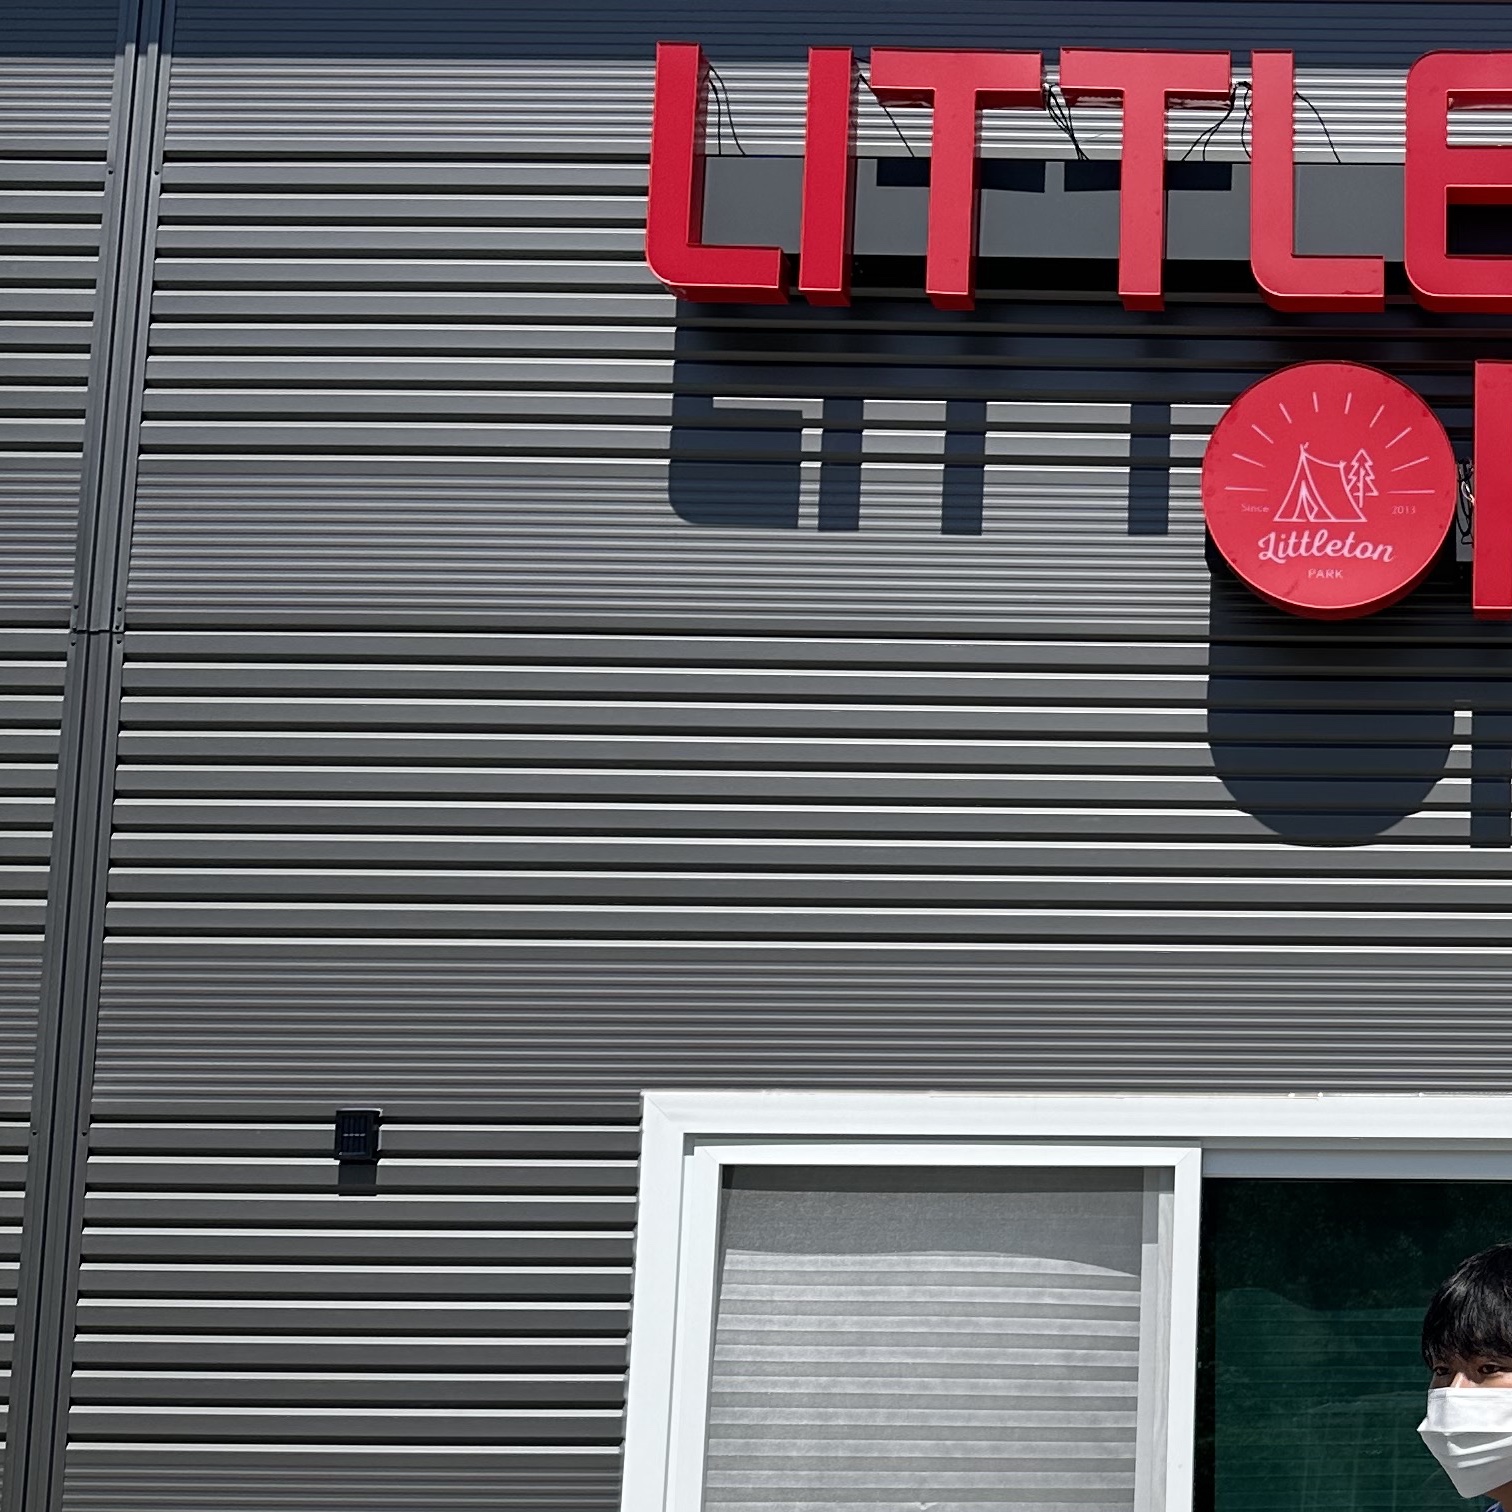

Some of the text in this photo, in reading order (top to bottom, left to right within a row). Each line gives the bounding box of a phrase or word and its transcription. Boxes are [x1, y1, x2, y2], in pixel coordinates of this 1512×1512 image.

[1240, 502, 1270, 514] Since
[1258, 529, 1394, 564] Littleton
[1307, 568, 1345, 580] PARK
